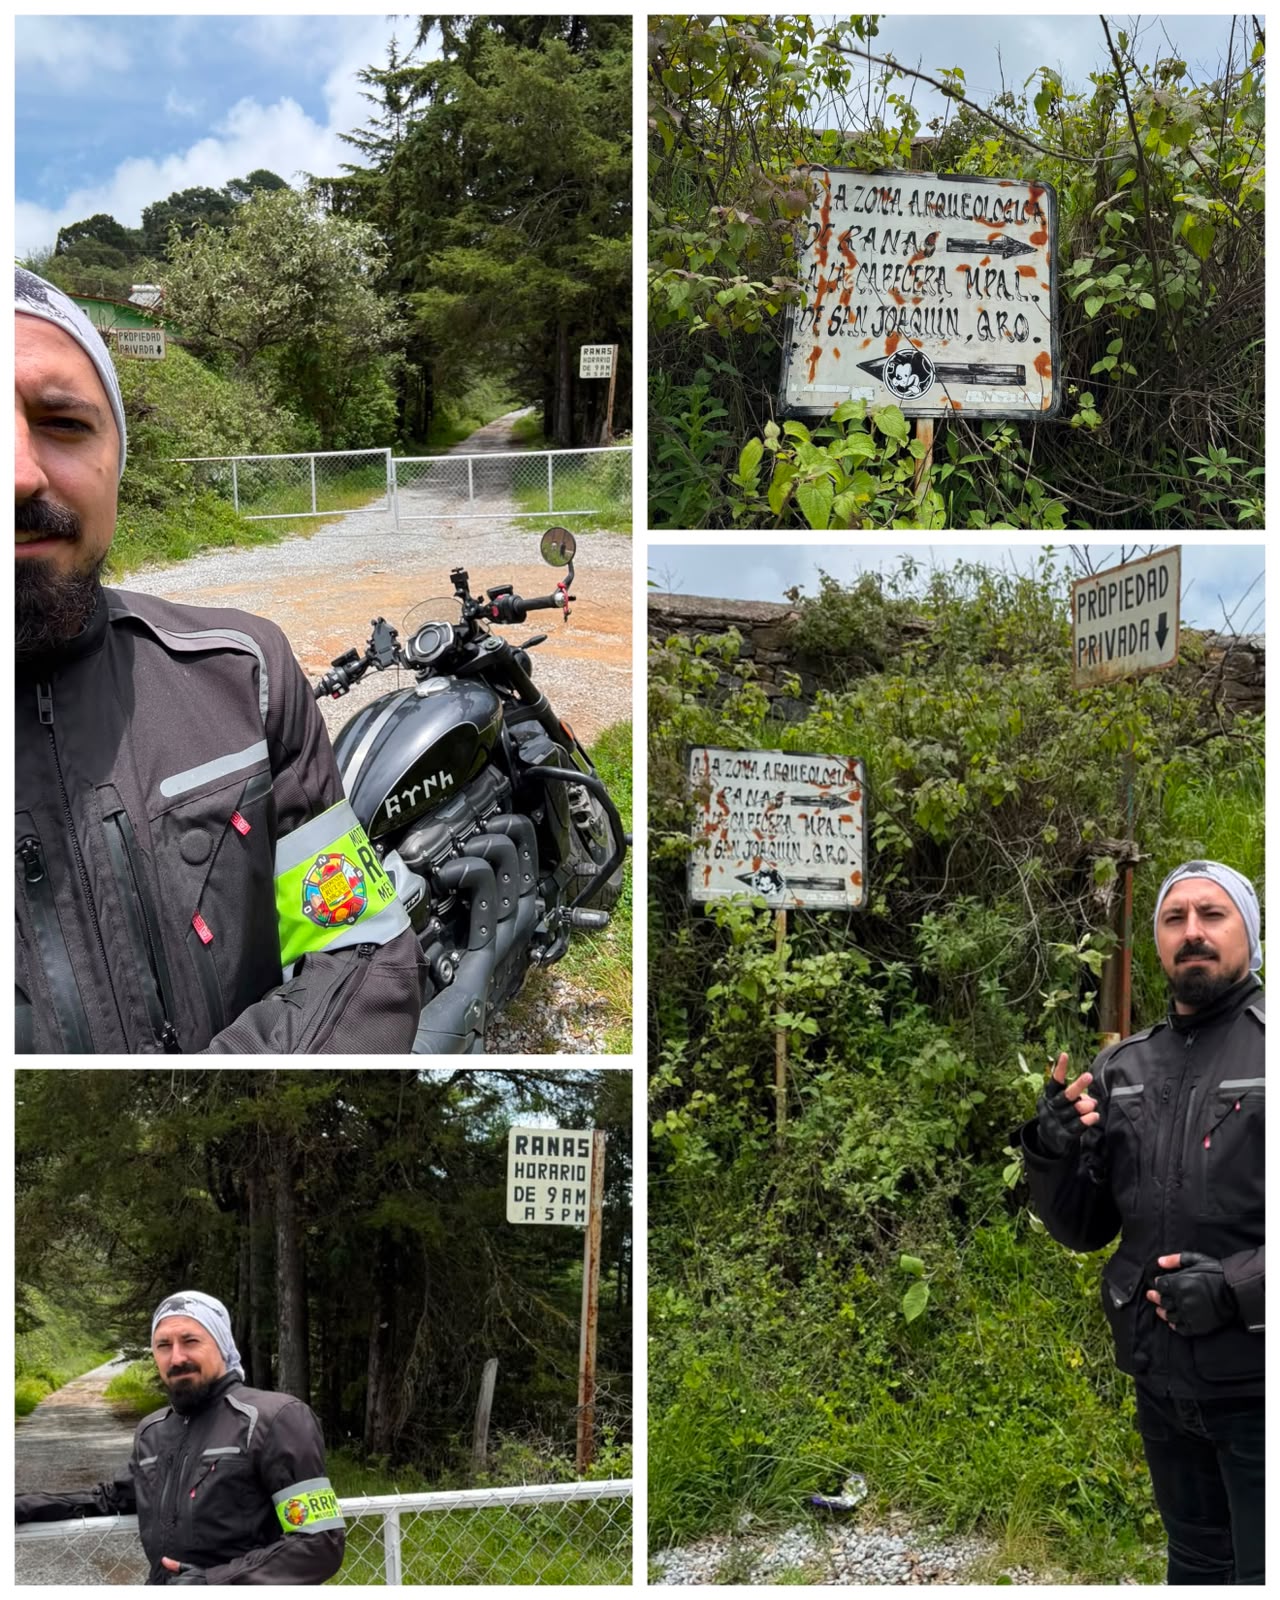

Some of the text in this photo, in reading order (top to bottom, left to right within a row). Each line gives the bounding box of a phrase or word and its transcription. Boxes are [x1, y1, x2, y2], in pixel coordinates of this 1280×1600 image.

[853, 184, 903, 217] ZONA
[836, 224, 941, 259] RANAS
[855, 262, 953, 297] CABECERA
[827, 304, 868, 337] SAN
[118, 331, 161, 342] PROPIEDAD
[119, 344, 155, 355] PRIVADA
[583, 347, 612, 355] RANAS
[1077, 564, 1169, 625] PROPIEDAD
[1077, 617, 1150, 668] PRIVADA
[515, 1134, 590, 1158] RANAS
[514, 1161, 586, 1182] HORARIO
[513, 1185, 536, 1203] DE
[524, 1206, 535, 1221] A
